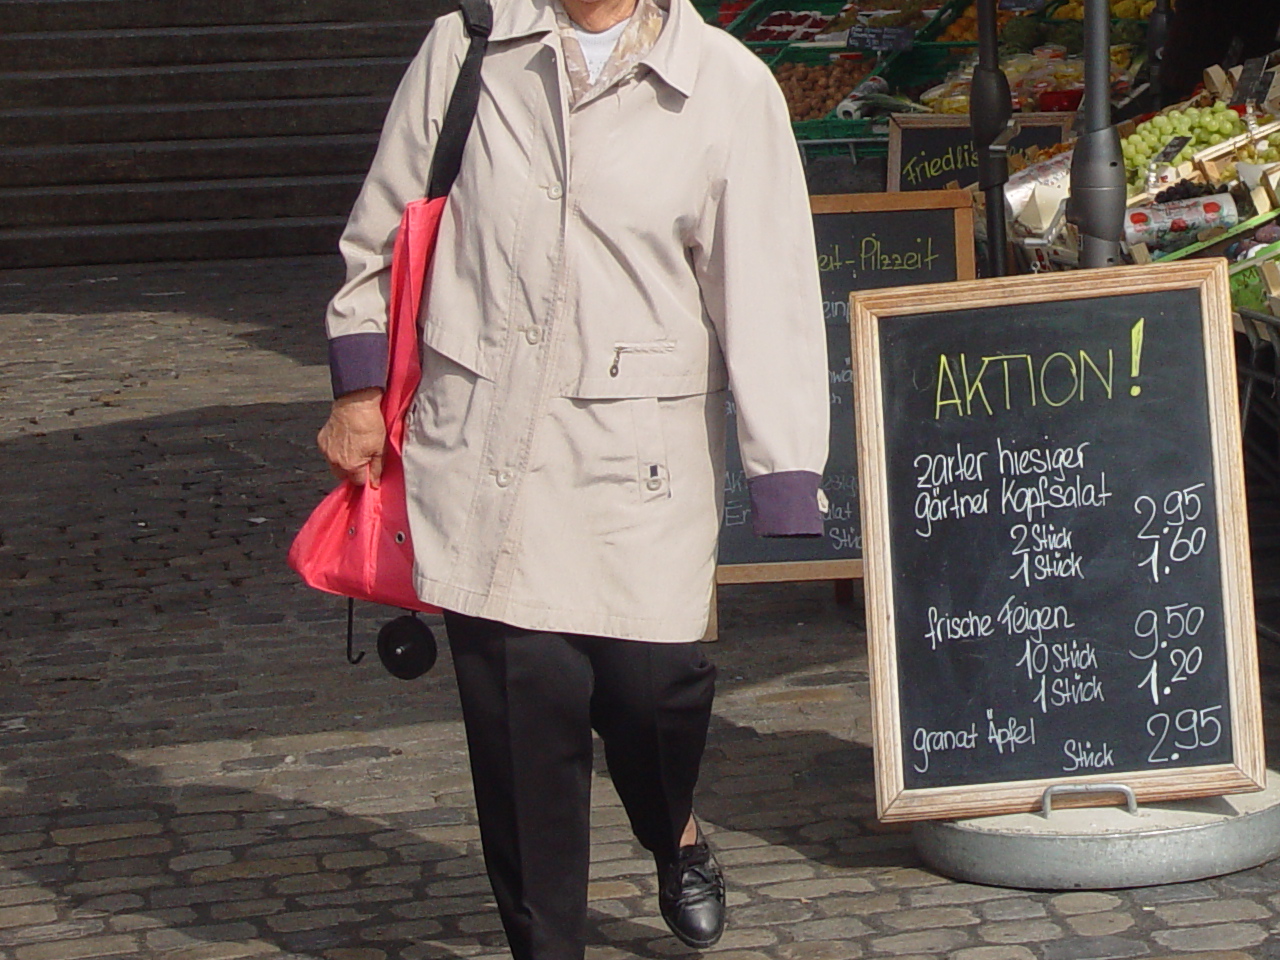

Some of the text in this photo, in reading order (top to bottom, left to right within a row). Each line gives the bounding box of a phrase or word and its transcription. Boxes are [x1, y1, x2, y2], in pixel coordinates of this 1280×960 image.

[914, 443, 988, 488] zarter
[997, 435, 1090, 481] hiesiger
[1010, 483, 1205, 555] 2 Stück 2.95
[1010, 527, 1206, 587] 1 Stück 1.60
[1016, 603, 1204, 680] 10 Stück 9.50
[1033, 646, 1203, 713] 1 Stück 1.20
[1063, 705, 1223, 771] Stück 2.95
